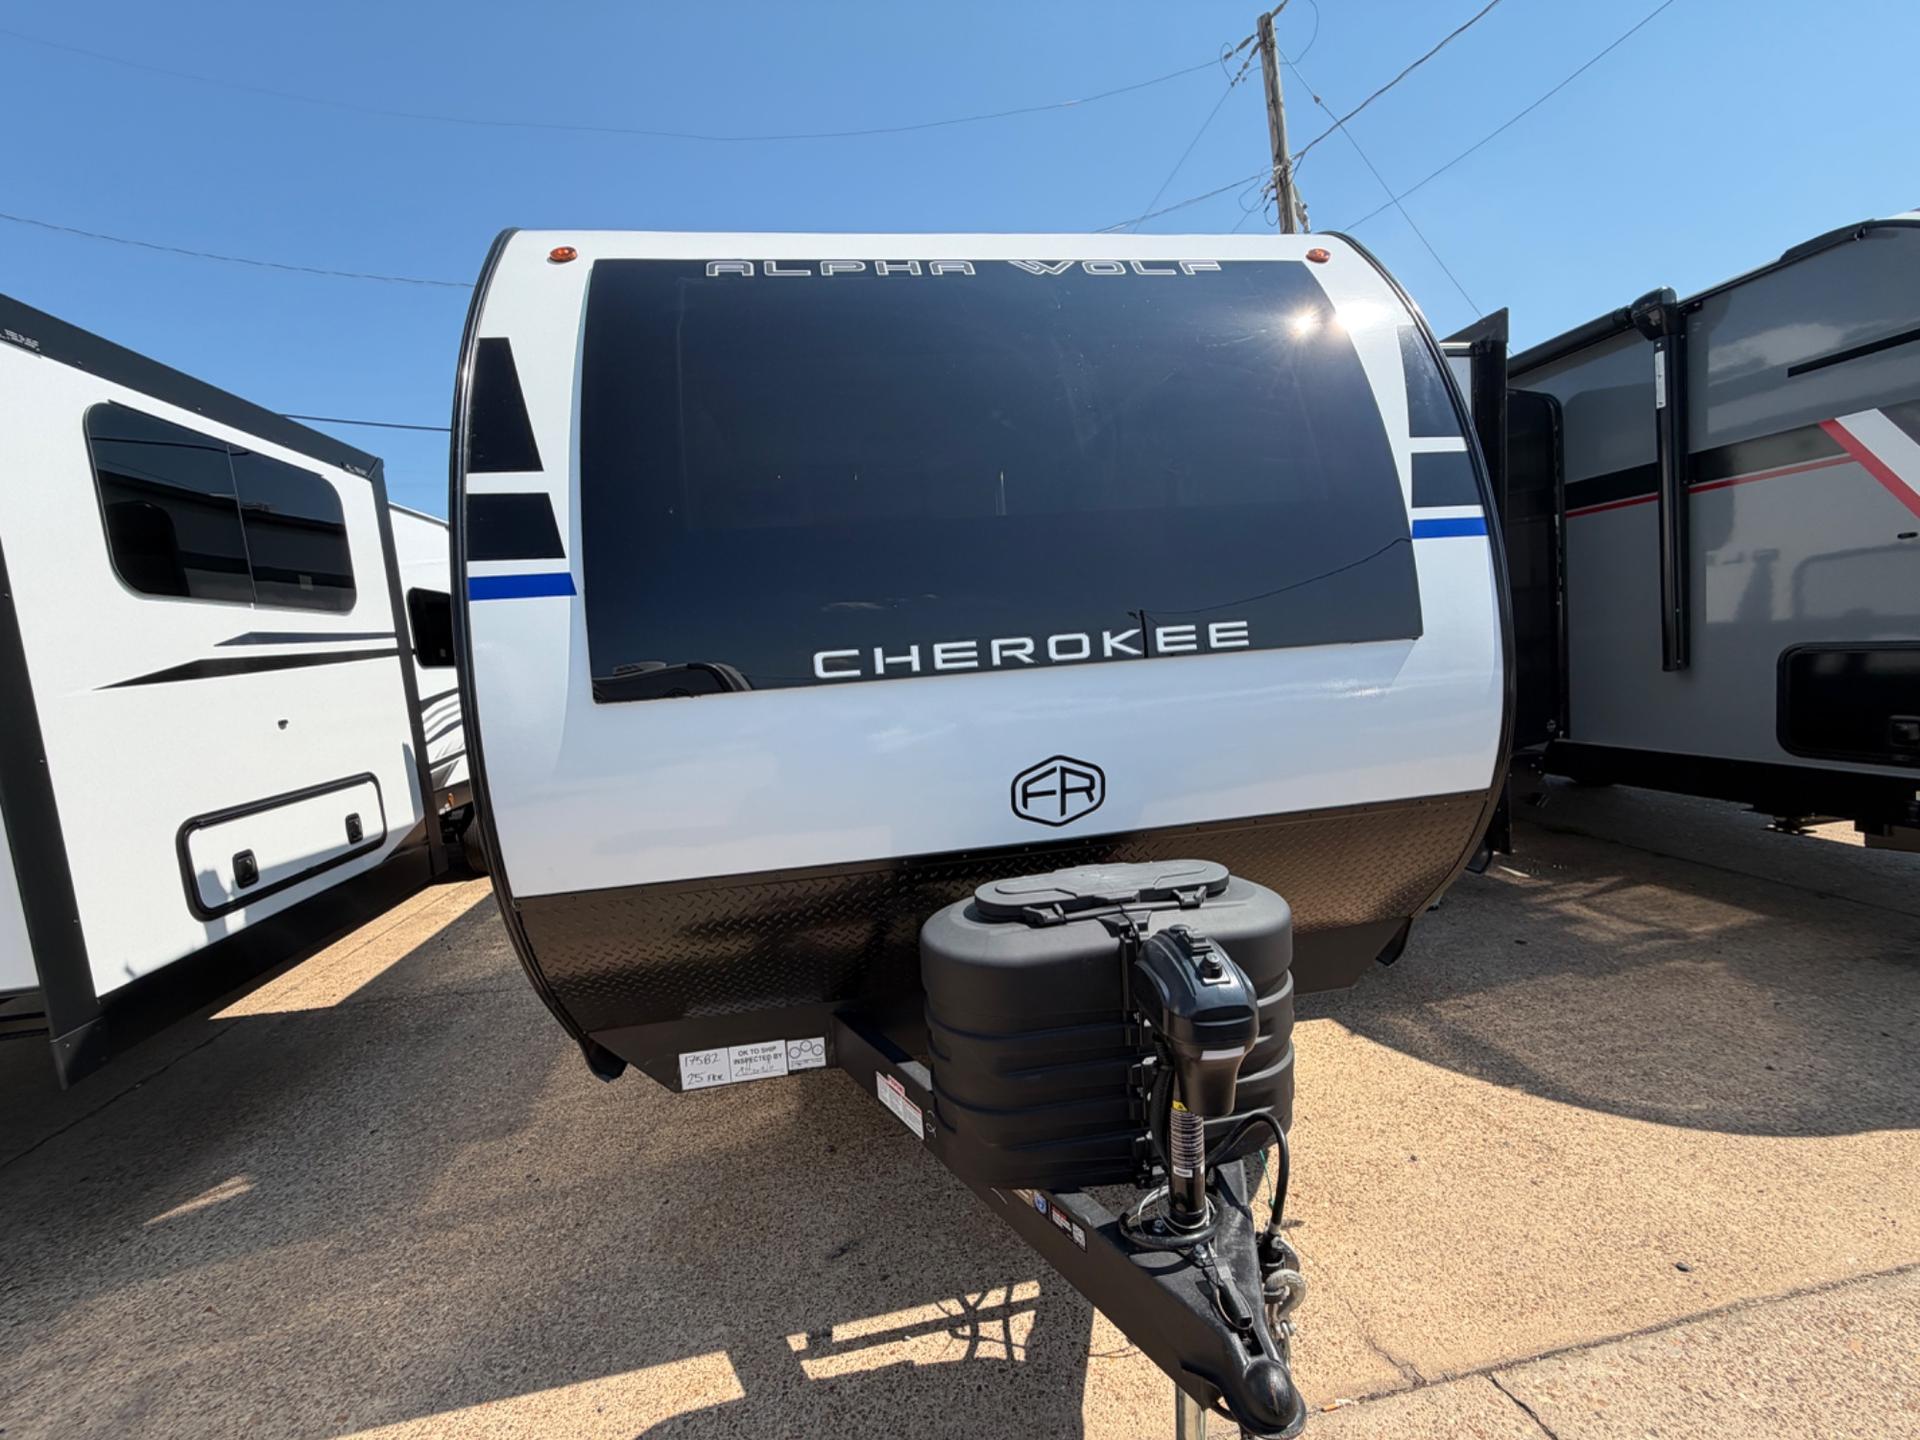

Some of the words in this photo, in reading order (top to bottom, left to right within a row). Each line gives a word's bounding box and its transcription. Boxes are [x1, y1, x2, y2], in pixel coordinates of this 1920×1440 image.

[705, 259, 976, 278] ALPHA
[1008, 259, 1223, 277] WOLF
[813, 619, 1251, 679] CHEROKEE
[773, 1052, 783, 1060] BY
